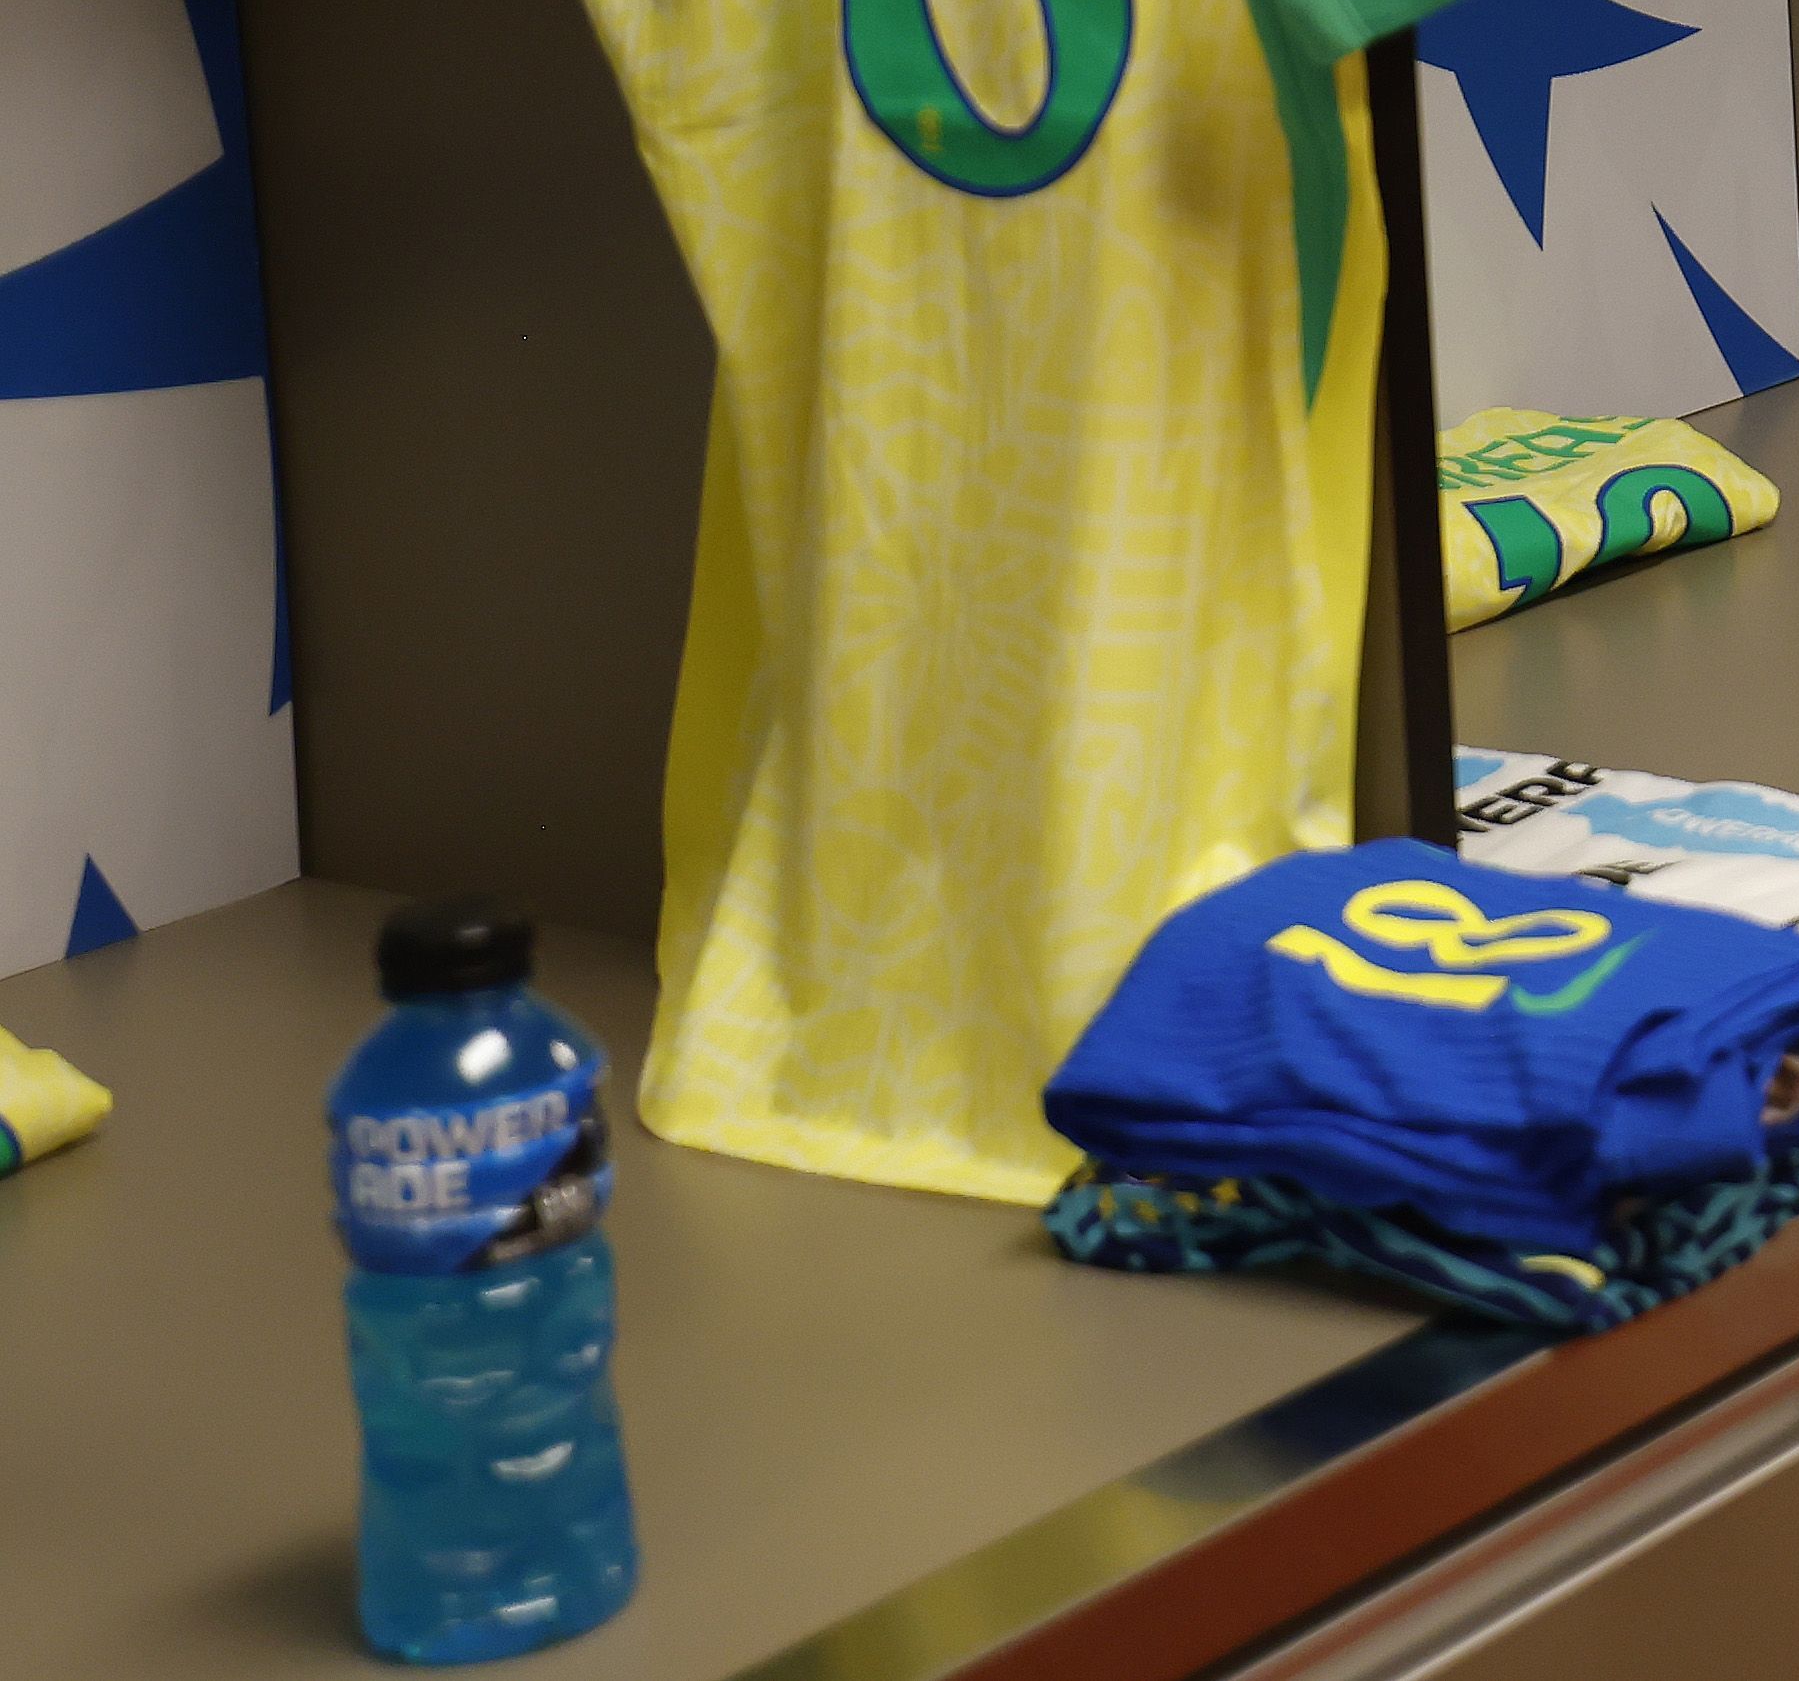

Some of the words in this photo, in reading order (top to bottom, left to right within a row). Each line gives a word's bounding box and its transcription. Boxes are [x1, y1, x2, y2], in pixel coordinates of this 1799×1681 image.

[1267, 880, 1611, 1011] 18
[348, 1090, 567, 1161] POWER
[350, 1160, 472, 1211] ADE
